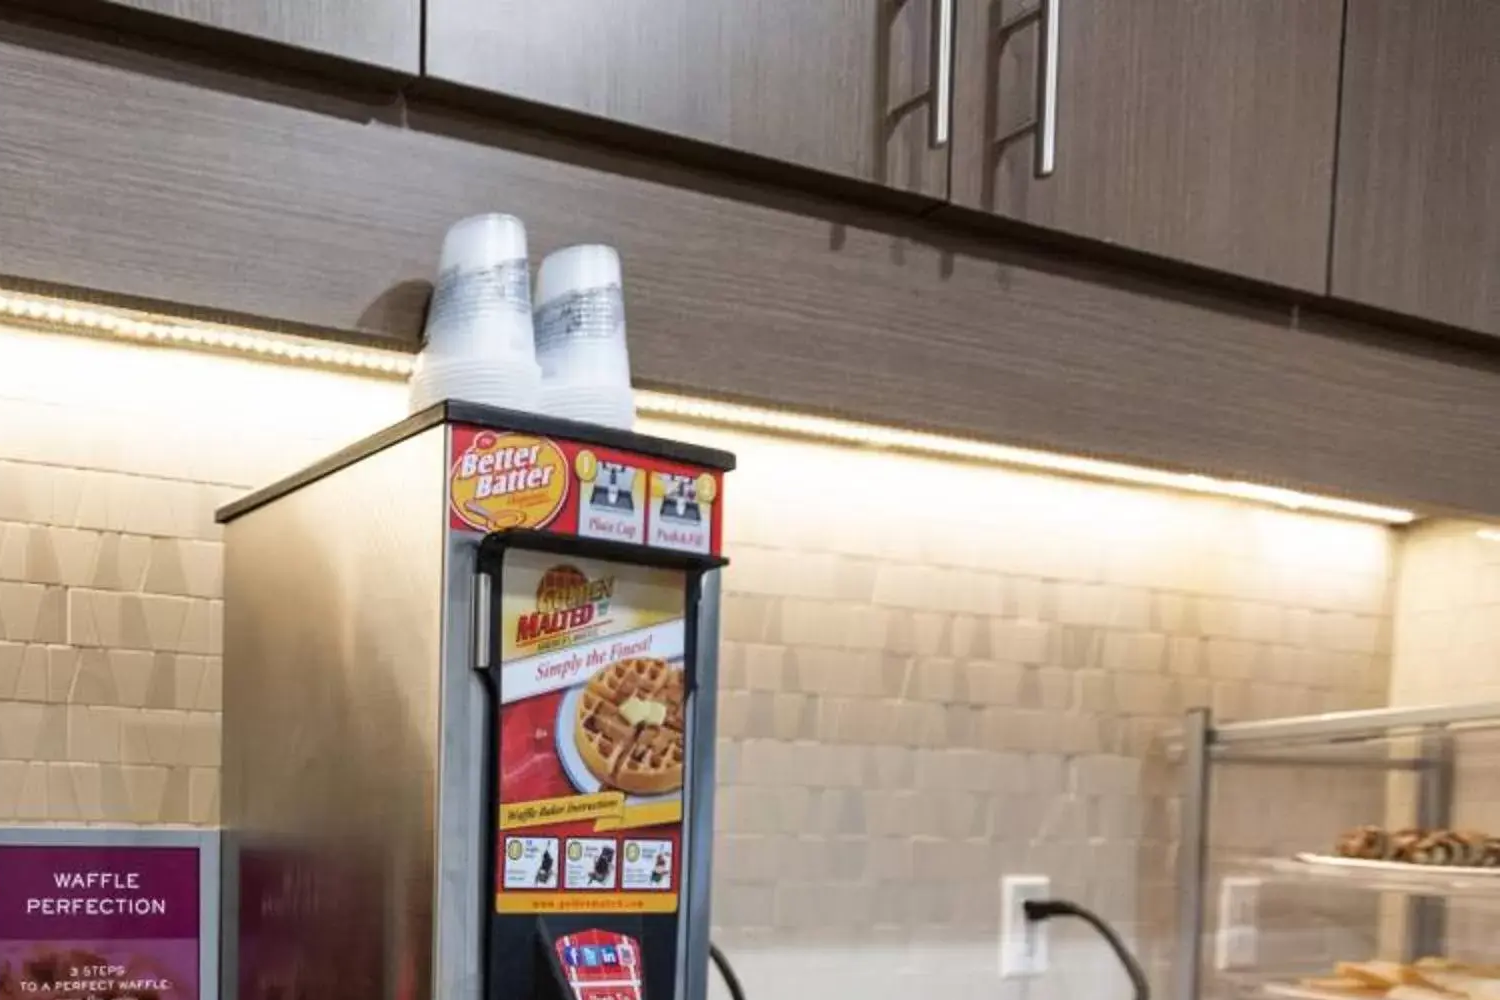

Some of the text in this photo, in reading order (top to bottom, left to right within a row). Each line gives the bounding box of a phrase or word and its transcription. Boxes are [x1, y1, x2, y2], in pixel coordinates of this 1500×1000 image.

[462, 445, 540, 478] Better
[476, 465, 555, 499] Batter
[516, 603, 595, 642] MALTED
[535, 652, 581, 680] Simply
[586, 648, 607, 667] the
[53, 872, 141, 890] WAFFLE
[26, 898, 166, 916] PERFECTION
[83, 965, 126, 978] STEPS
[20, 981, 38, 992] TO
[41, 980, 51, 992] A
[55, 979, 114, 991] PERFECT
